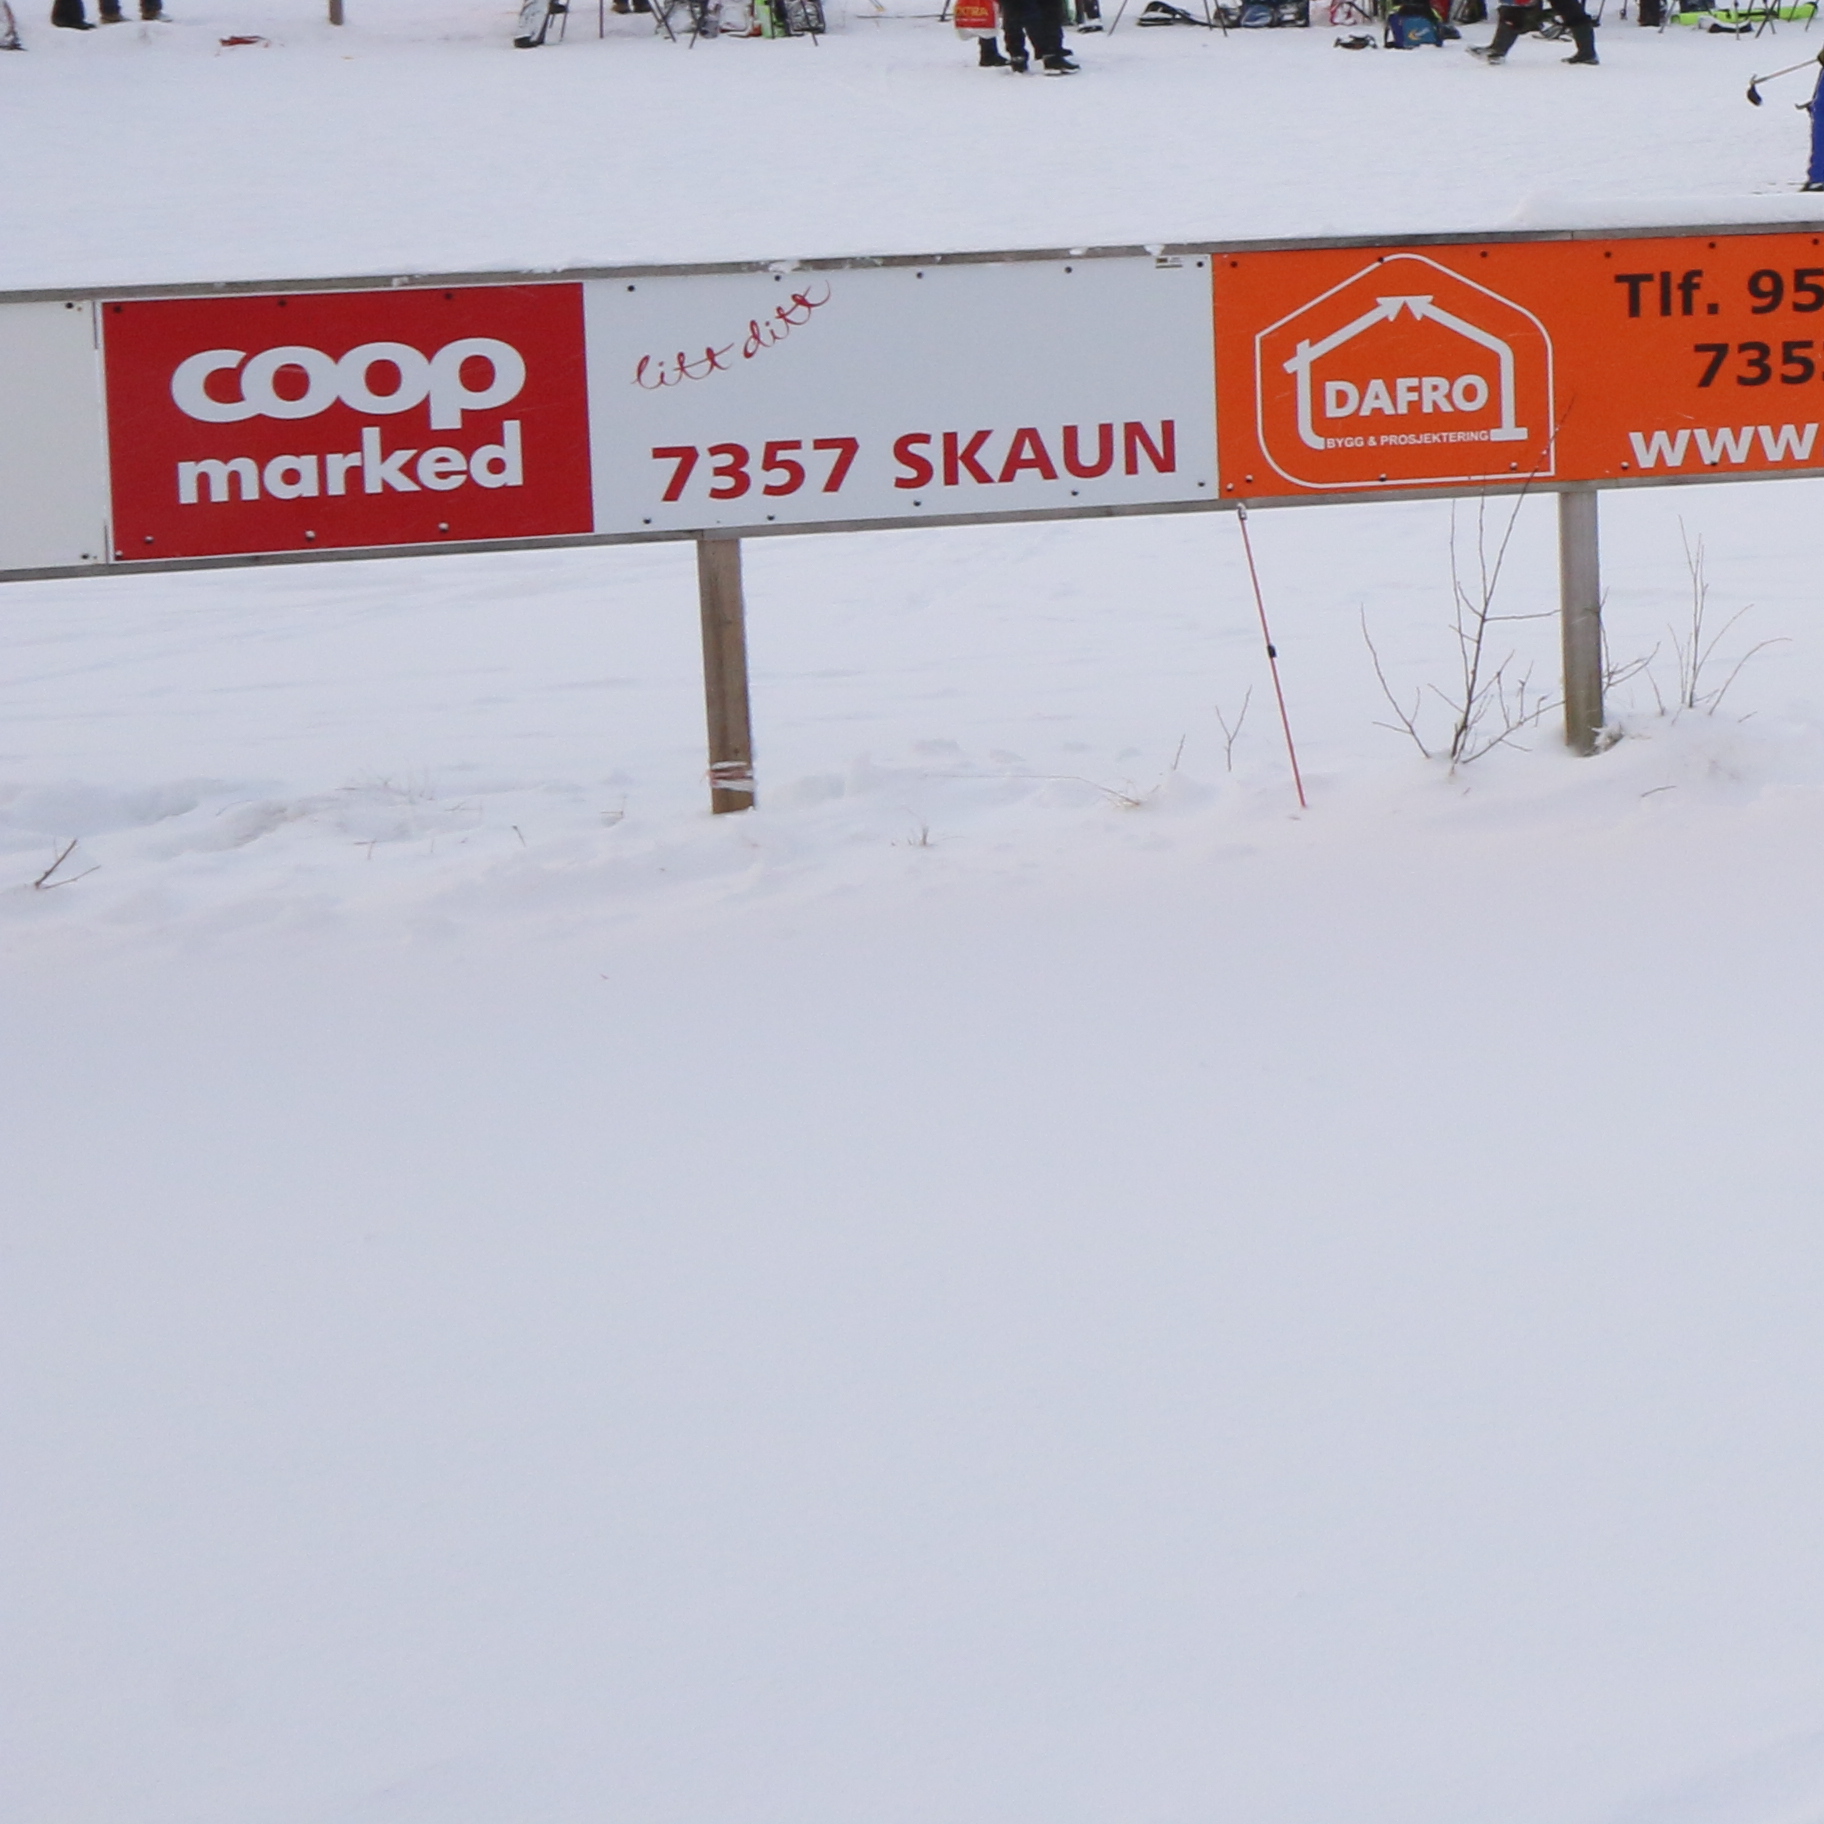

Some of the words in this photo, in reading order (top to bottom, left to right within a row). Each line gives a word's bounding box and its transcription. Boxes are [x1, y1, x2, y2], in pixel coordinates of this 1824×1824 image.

[1615, 269, 1720, 318] Tlf.
[172, 337, 526, 430] coop
[631, 342, 734, 390] litt
[1325, 375, 1489, 418] DAFRO
[178, 420, 524, 505] marked
[652, 436, 860, 503] 7357
[893, 419, 1177, 490] SKAUN
[1326, 436, 1364, 449] BYGG
[1367, 435, 1377, 447] &
[1380, 430, 1489, 445] PROSJEKTERING
